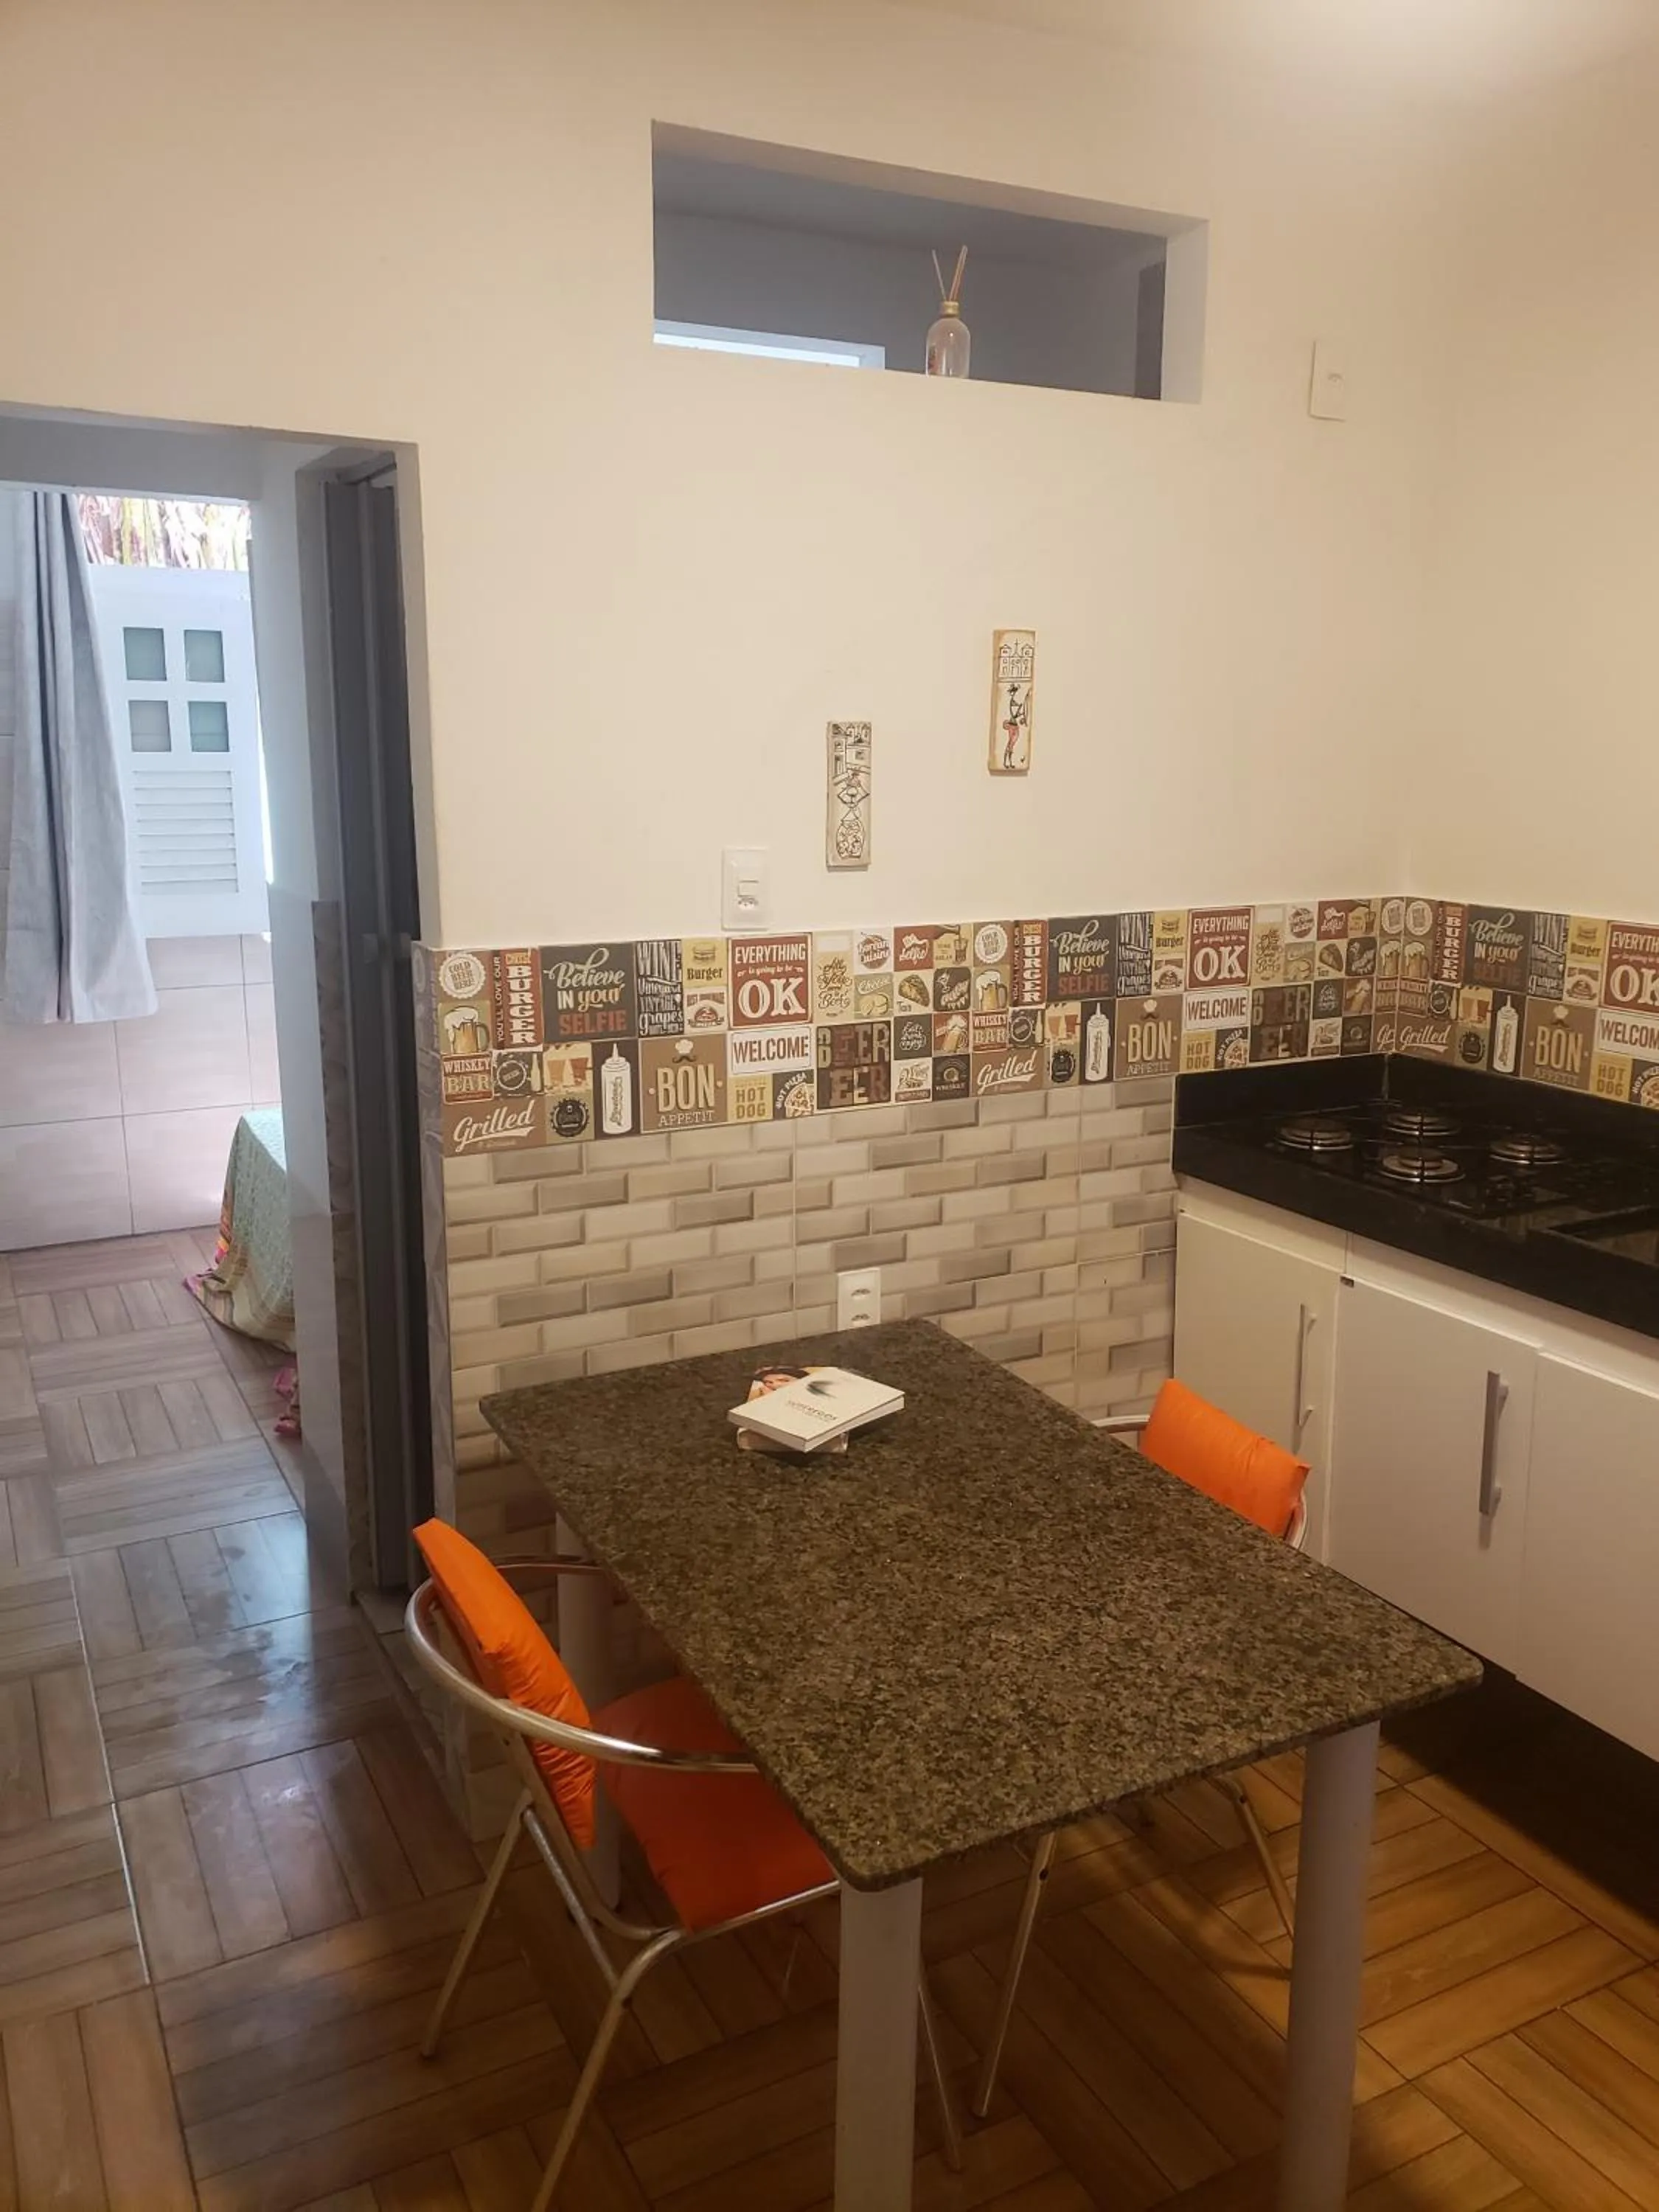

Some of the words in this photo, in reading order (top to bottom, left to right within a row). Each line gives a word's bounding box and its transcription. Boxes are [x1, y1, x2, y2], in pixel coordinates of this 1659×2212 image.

[1193, 915, 1249, 934] EVERYTHING
[1468, 912, 1524, 946] Believe
[1050, 920, 1109, 955] Believe
[1441, 917, 1461, 981] BURGER
[636, 942, 682, 983] WINE
[735, 943, 806, 964] EVERYTHING
[1059, 956, 1071, 973] IN
[1073, 950, 1109, 975] your
[1194, 945, 1246, 981] OK
[493, 956, 501, 979] OUR
[543, 947, 625, 989] Believe
[686, 967, 723, 981] Burger
[1022, 934, 1043, 1003] BURGER
[494, 981, 502, 1006] LOVE
[1059, 974, 1108, 995] SELFIE
[507, 965, 536, 1045] BURGER
[557, 990, 574, 1010] IN
[577, 983, 625, 1012] your
[738, 977, 807, 1018] OK
[1188, 997, 1246, 1021] WELCOME
[558, 1009, 627, 1035] SELFIE
[973, 1014, 1006, 1027] WHISKEY
[734, 1035, 809, 1064] WELCOME
[1127, 1020, 1172, 1063] BON
[1186, 1041, 1211, 1057] HOT
[1399, 1025, 1451, 1051] Grilled
[1534, 1026, 1583, 1074] BON
[443, 1057, 491, 1074] WHISKEY
[977, 1050, 1037, 1095] Grilled
[1186, 1056, 1210, 1070] DOG
[1597, 1064, 1626, 1081] HOT
[446, 1074, 490, 1093] BAR
[656, 1062, 715, 1113] BON
[736, 1087, 766, 1103] HOT
[1596, 1079, 1624, 1097] DOG
[658, 1109, 715, 1127] APPETIT
[737, 1102, 766, 1119] DOG
[453, 1099, 535, 1152] Grilled
